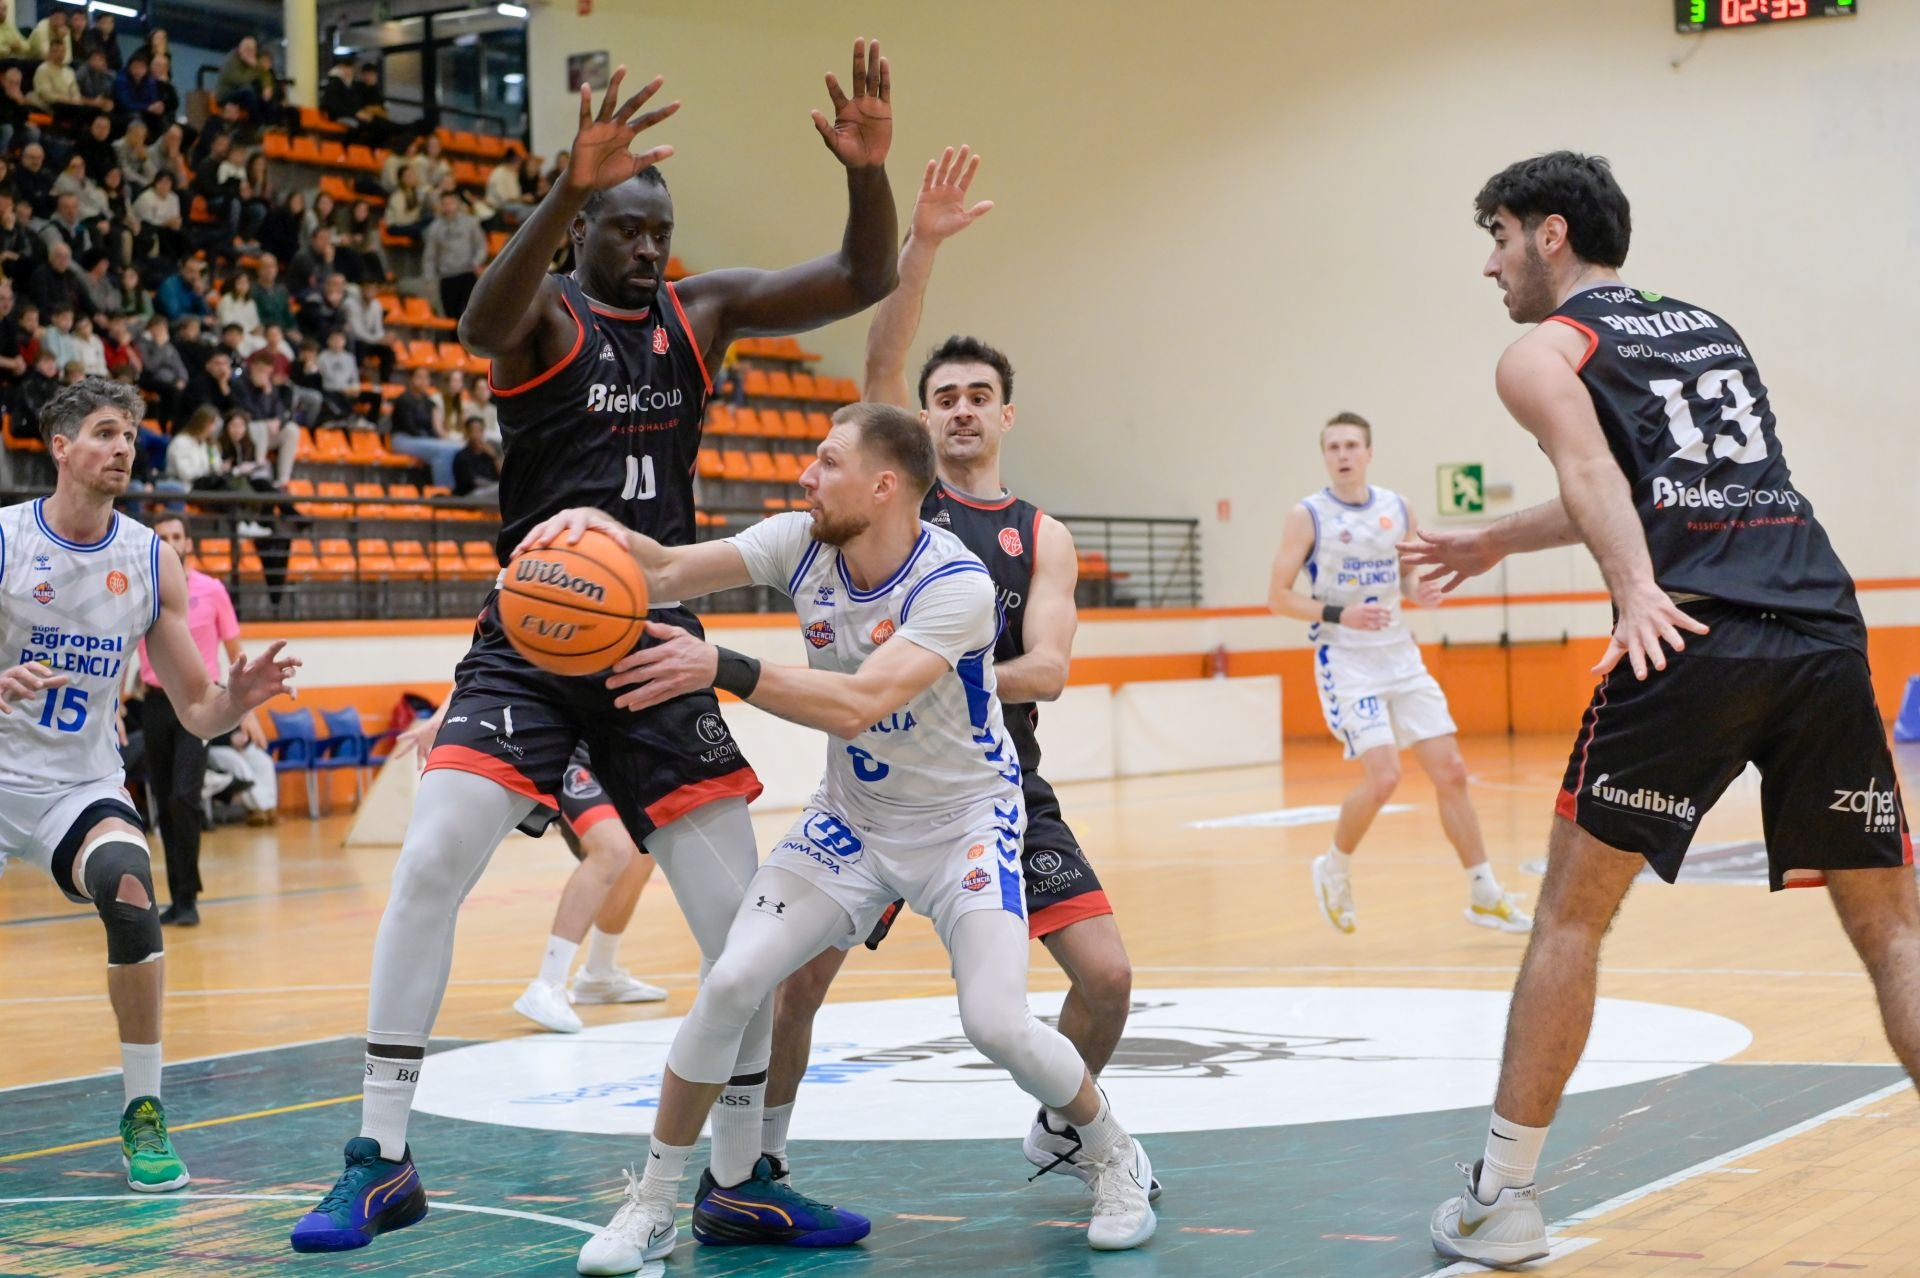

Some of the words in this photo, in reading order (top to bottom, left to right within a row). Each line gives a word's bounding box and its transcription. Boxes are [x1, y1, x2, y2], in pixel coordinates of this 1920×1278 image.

[1648, 369, 1769, 465] 13
[1652, 476, 1800, 513] BieleGroup
[515, 560, 606, 601] Wilson
[30, 631, 122, 652] agropal
[38, 686, 89, 734] 15
[700, 742, 739, 763] AZKOITI
[1592, 773, 1696, 822] fundibide
[782, 842, 840, 875] INMAPA
[1032, 868, 1083, 895] AZKOITIA
[396, 1069, 419, 1083] BO
